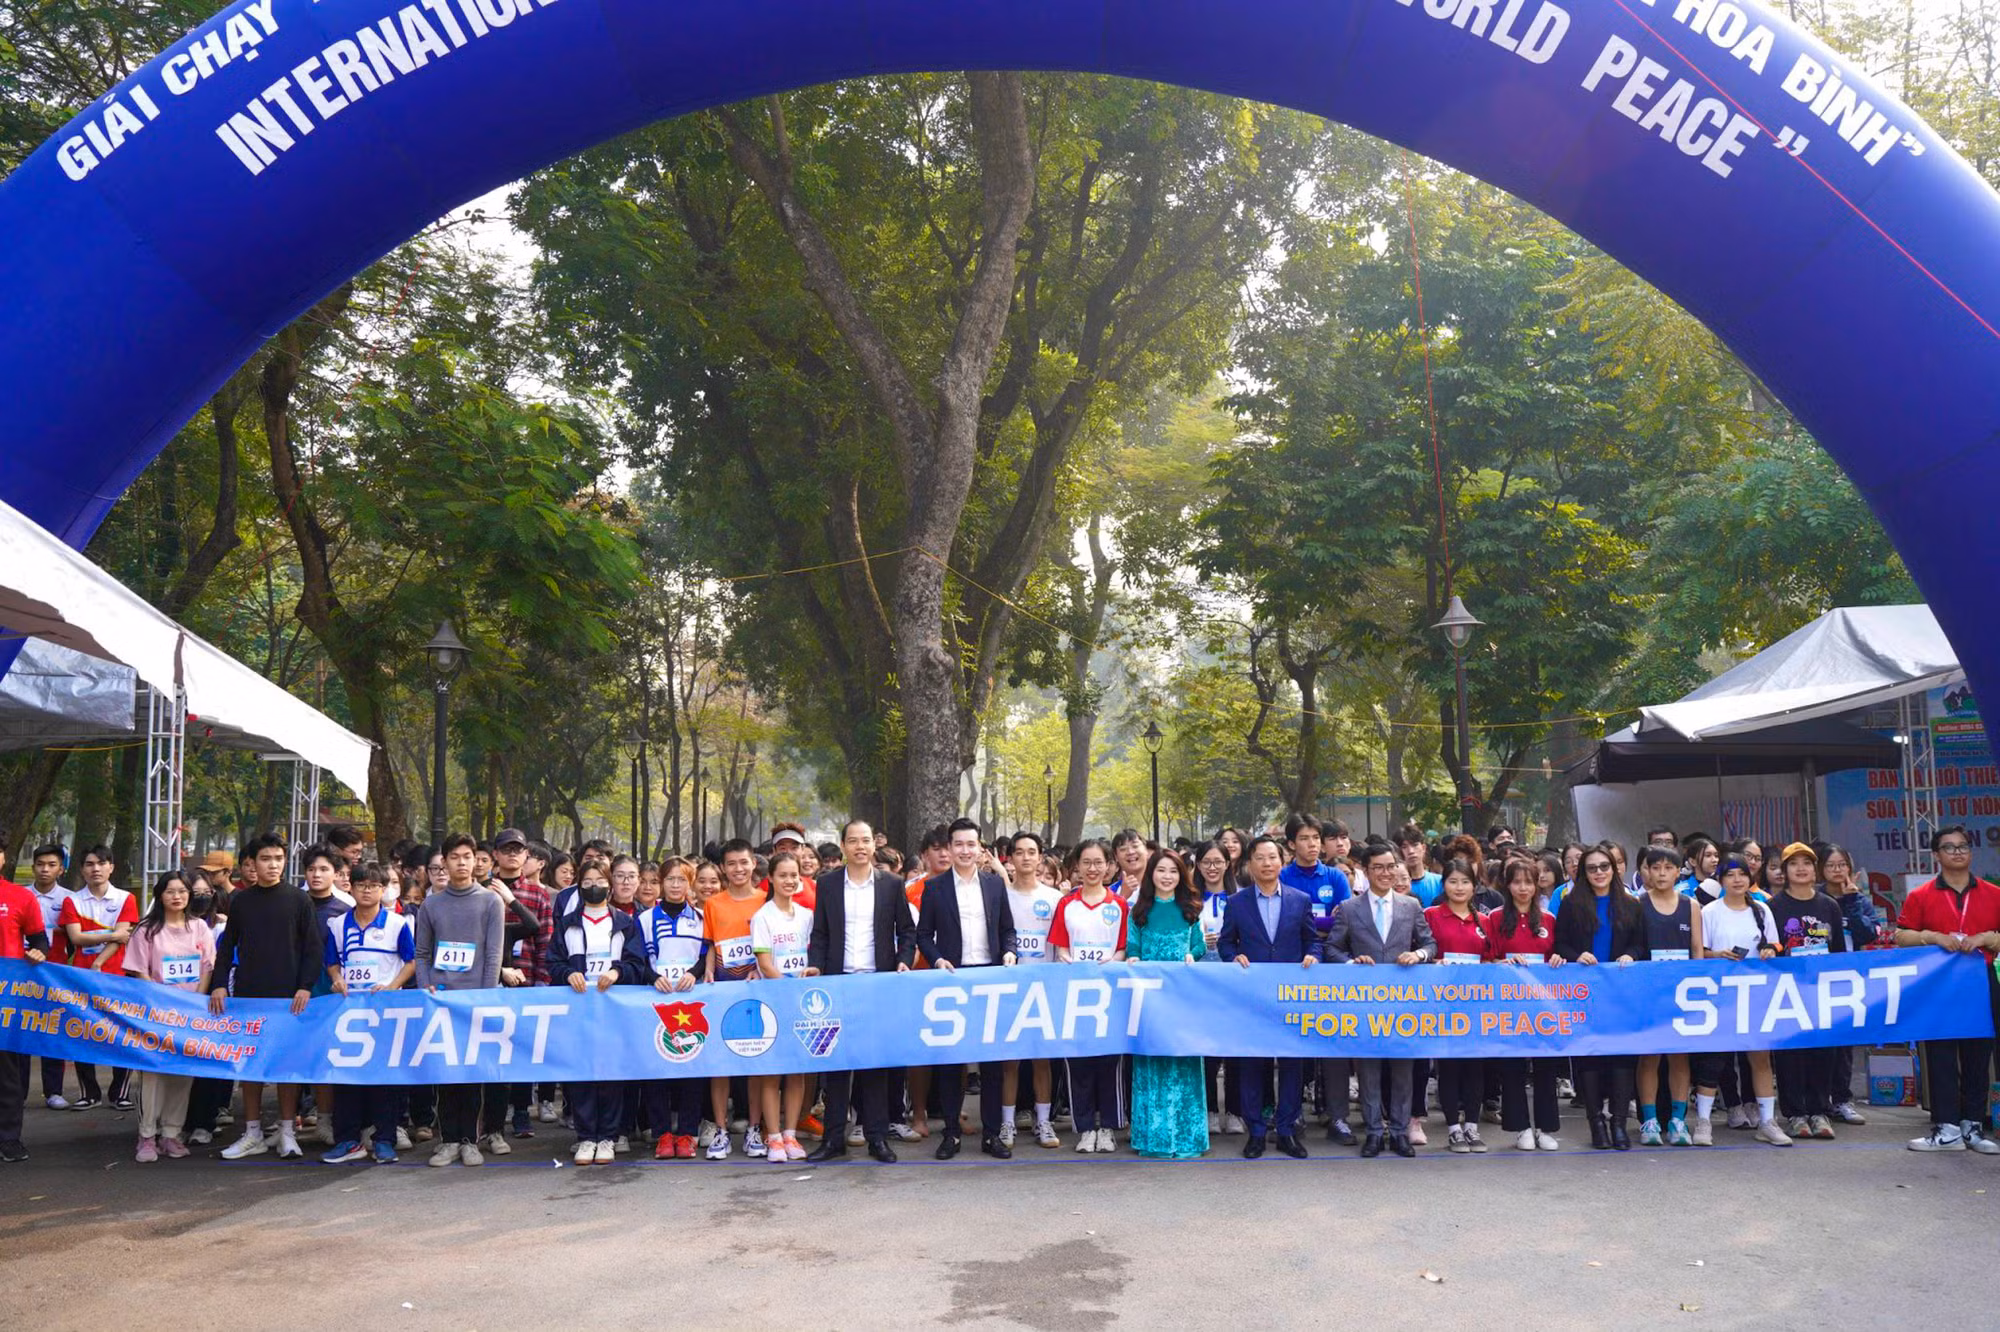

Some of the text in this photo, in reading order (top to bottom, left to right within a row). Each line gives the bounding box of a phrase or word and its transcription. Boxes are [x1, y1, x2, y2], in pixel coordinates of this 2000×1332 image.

[215, 0, 560, 176] INTERNATIO
[1396, 0, 1571, 65] ORLD
[1581, 34, 1760, 178] PEACE
[728, 944, 753, 960] 490
[1016, 937, 1039, 950] 200
[442, 951, 467, 963] 611
[783, 957, 805, 969] 494
[1079, 950, 1104, 961] 342
[168, 963, 193, 975] 514
[348, 968, 371, 980] 286
[1277, 983, 1590, 1001] INTERNATIONAL YOUTH RUNNING
[1672, 965, 1918, 1036] START
[91, 995, 147, 1019] THANH
[148, 1006, 188, 1028] NIÊN
[919, 978, 1163, 1047] START
[1367, 1012, 1471, 1037] WORLD
[327, 1004, 570, 1068] START
